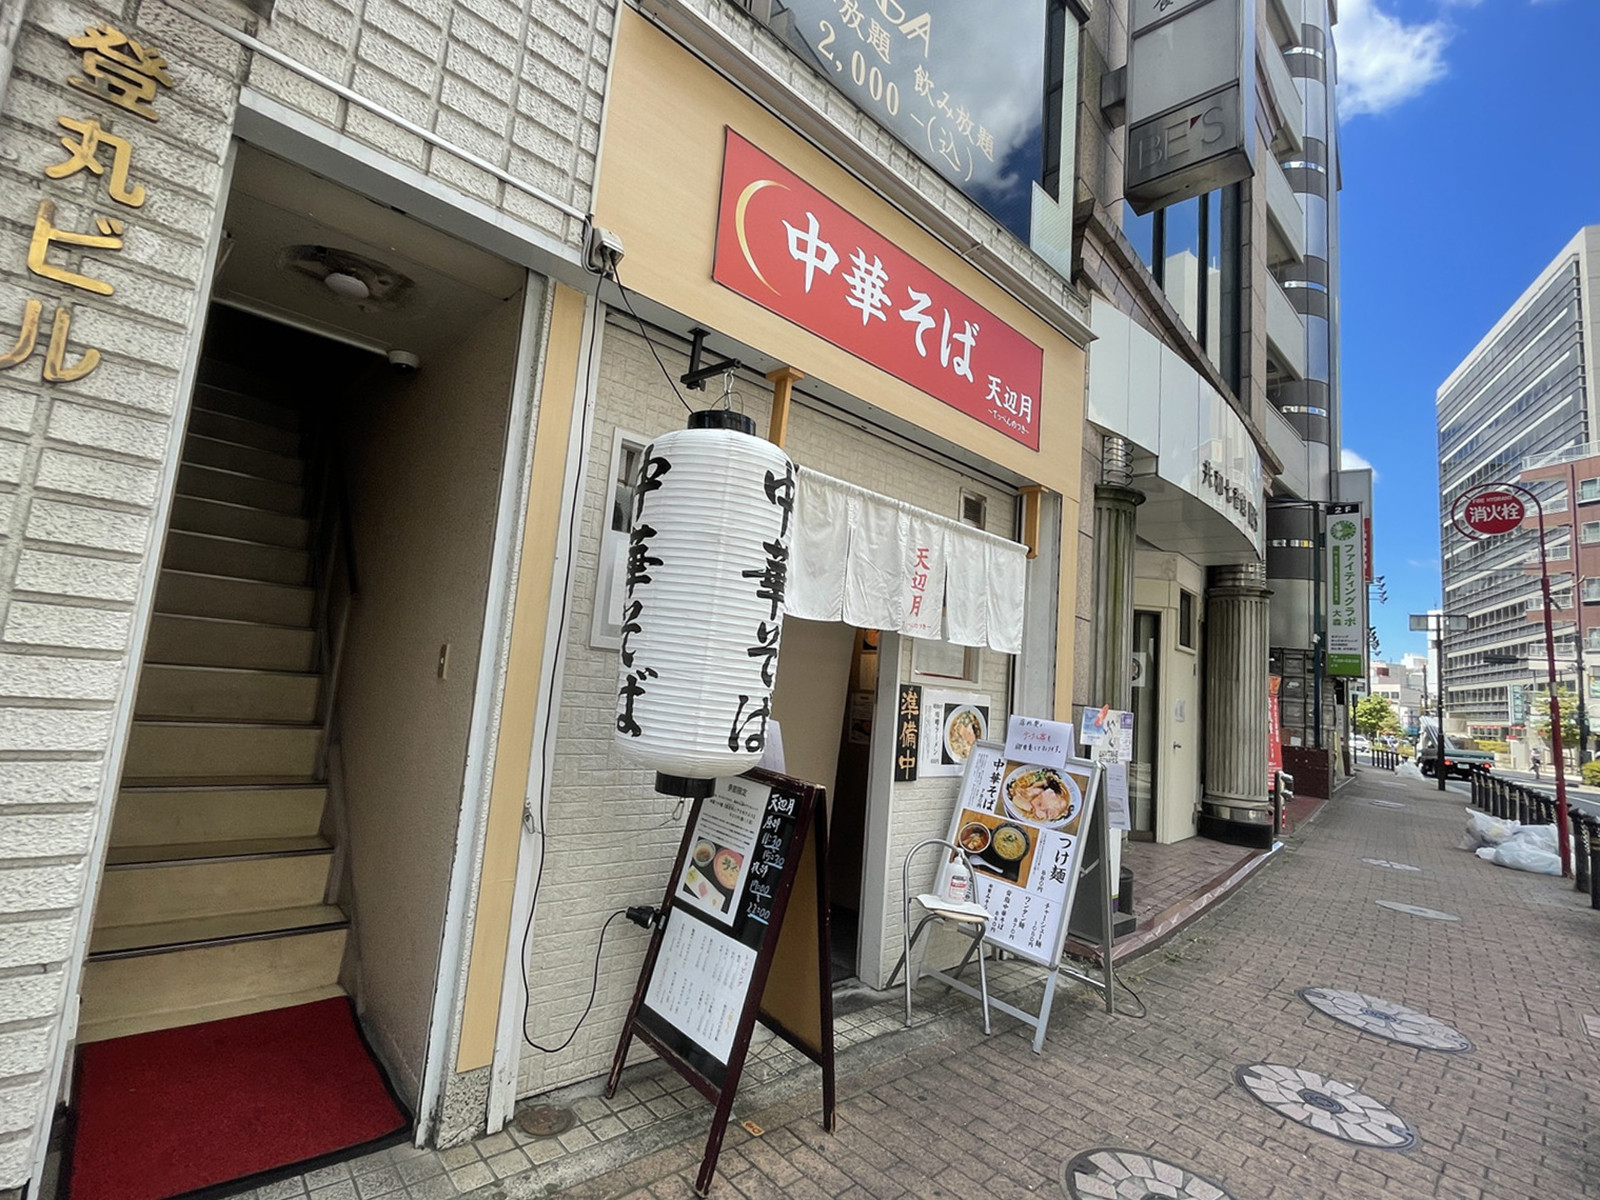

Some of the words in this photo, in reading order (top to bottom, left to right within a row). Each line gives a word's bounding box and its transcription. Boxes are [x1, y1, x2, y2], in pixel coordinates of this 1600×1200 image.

[833, 0, 891, 65] 放題
[914, 64, 994, 163] 飲み放題
[0, 24, 174, 382] 登丸ビル
[781, 211, 981, 383] 中華そば
[985, 374, 1033, 424] 天辺月
[1468, 502, 1521, 523] 消火栓
[909, 547, 931, 618] 天辺月
[898, 690, 920, 780] 準備中
[983, 758, 1005, 811] 中華そば
[1049, 837, 1072, 884] つけ麺
